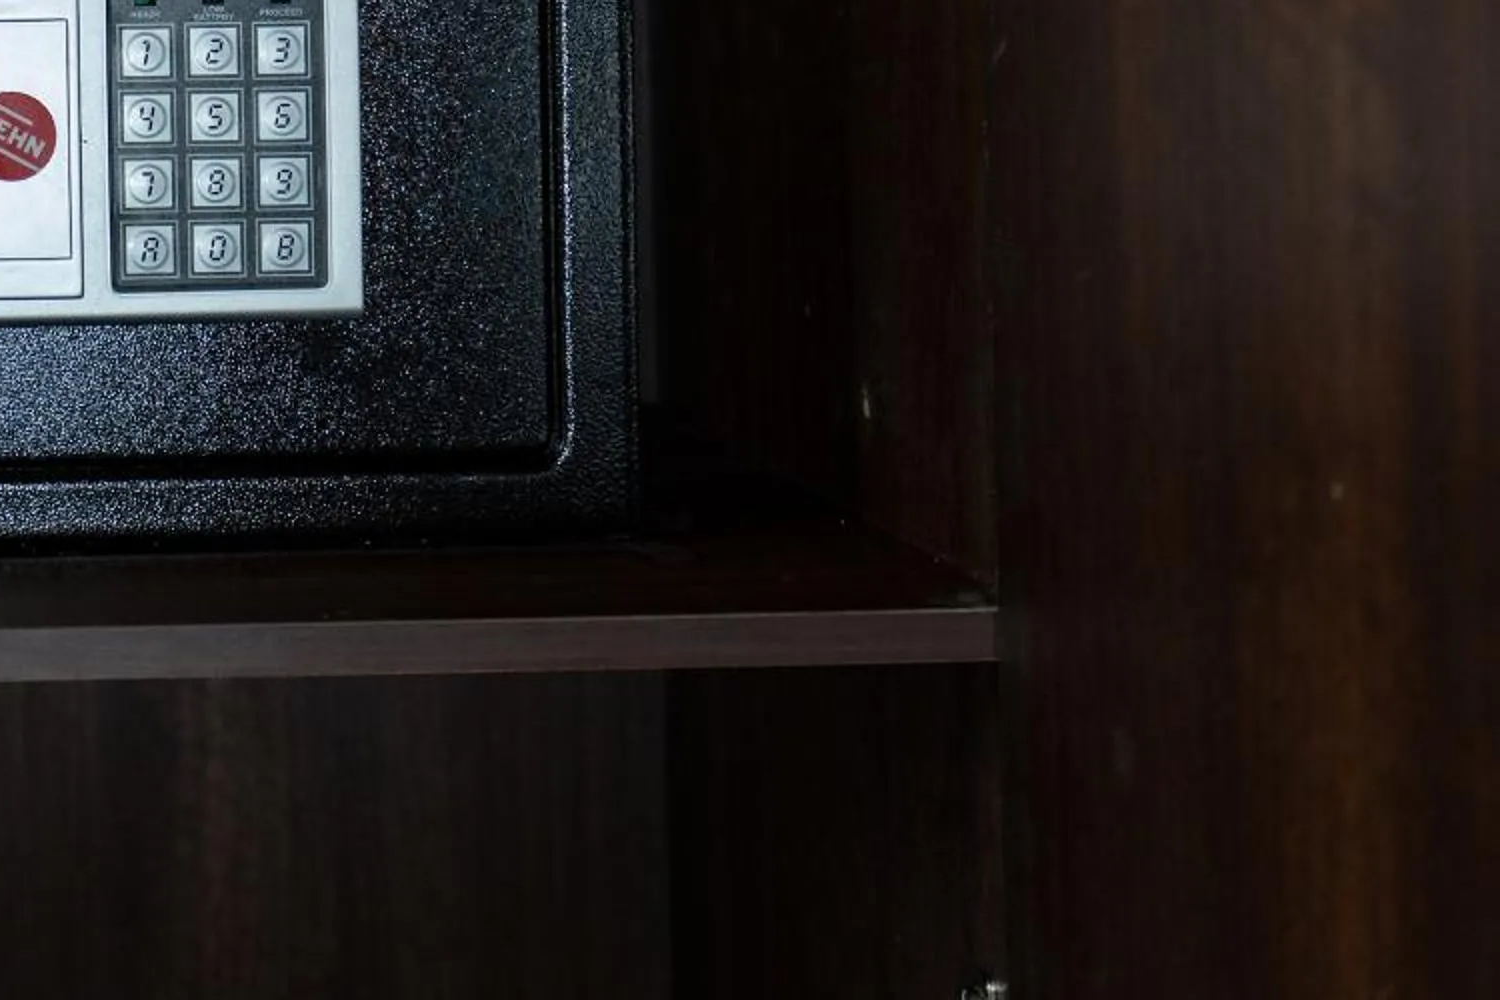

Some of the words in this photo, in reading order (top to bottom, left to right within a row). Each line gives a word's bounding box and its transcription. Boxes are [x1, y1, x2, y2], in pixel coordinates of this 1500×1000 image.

[142, 39, 151, 65] 1
[205, 38, 224, 64] 2
[274, 37, 291, 63] 3
[139, 106, 155, 131] 4
[208, 104, 223, 129] 5
[274, 103, 291, 128] 6
[141, 171, 155, 197] 7
[207, 169, 225, 195] 8
[276, 169, 293, 194] 9
[141, 237, 159, 262] A
[209, 235, 227, 261] 0
